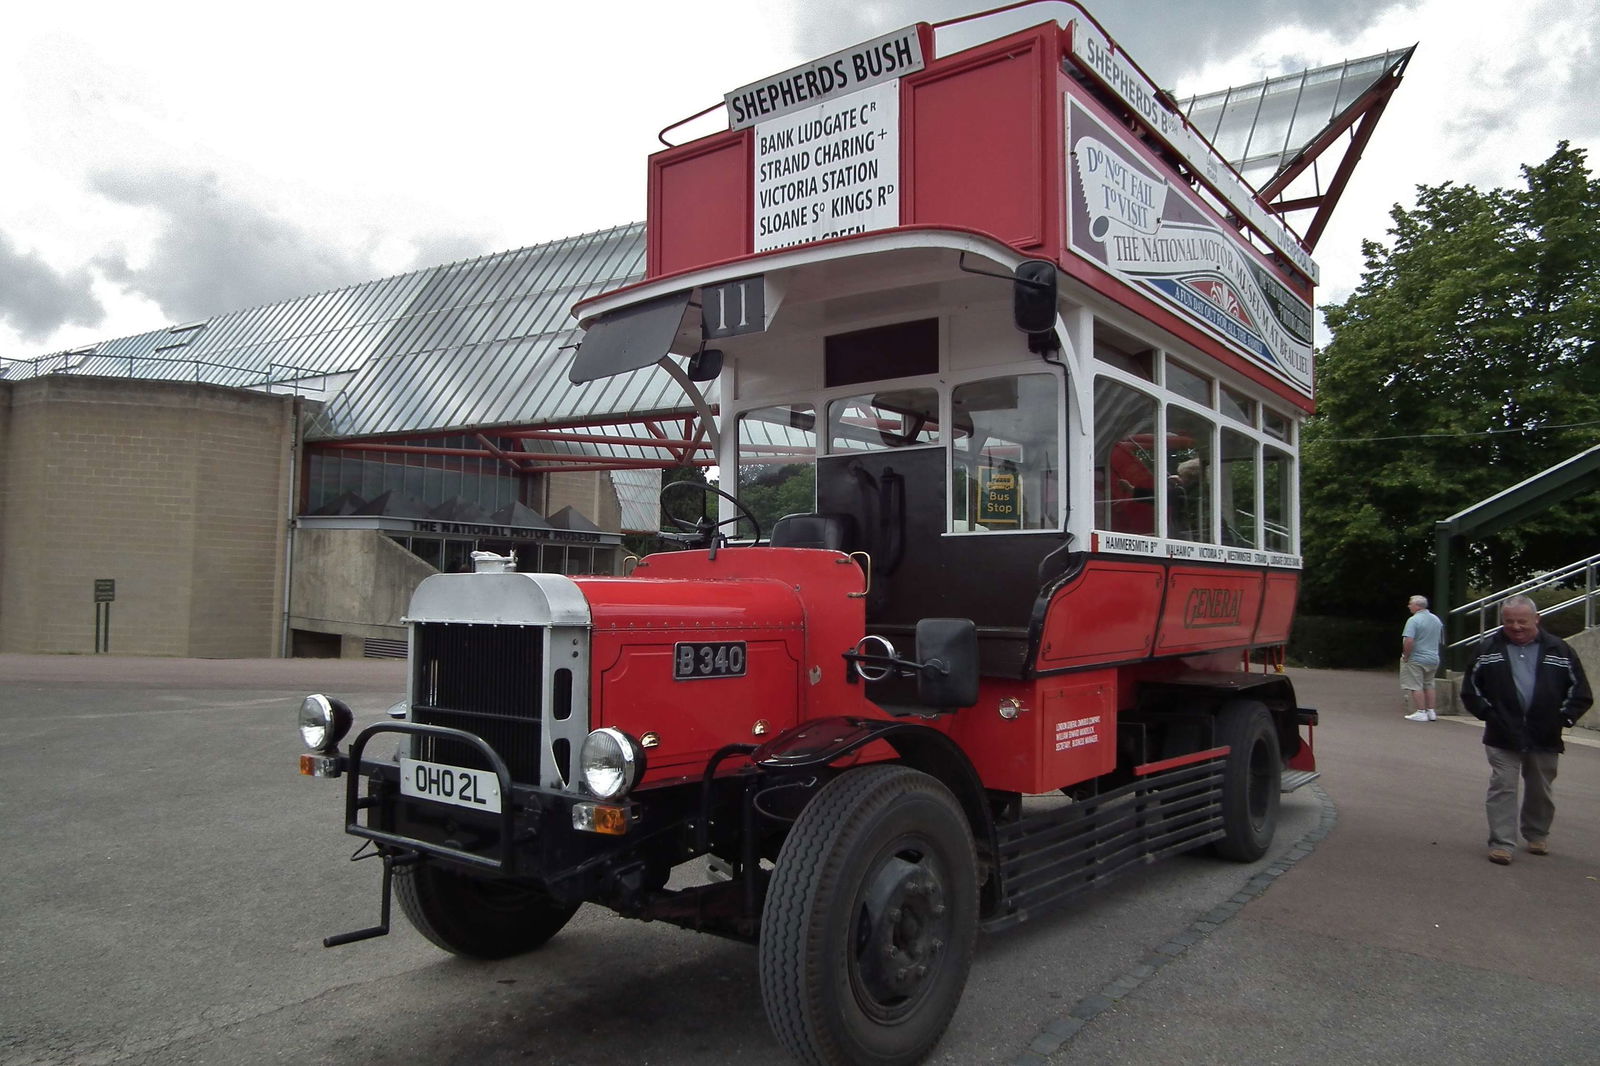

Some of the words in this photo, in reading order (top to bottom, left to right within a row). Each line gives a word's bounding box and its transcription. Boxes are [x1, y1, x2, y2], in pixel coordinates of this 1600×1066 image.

[732, 60, 848, 123] SHEPHERDS
[852, 37, 913, 83] BUSH
[1087, 38, 1158, 127] SHEPHERDS
[760, 127, 794, 157] BANK
[799, 106, 858, 144] LUDGATE
[760, 152, 810, 182] STRAND
[814, 130, 875, 167] CHARING
[760, 176, 818, 209] VICTORIA
[822, 159, 879, 193] STATION
[1131, 173, 1155, 209] FAIL
[760, 205, 808, 237] SLOANE
[831, 188, 873, 219] KINGS
[1117, 193, 1148, 229] VISIT
[1113, 235, 1140, 262] THE
[1141, 237, 1199, 263] NATIONAL
[1200, 239, 1233, 273] MOTOR
[1235, 260, 1269, 333] MUSEUM
[1270, 324, 1279, 348] AT
[1174, 286, 1180, 300] A
[1180, 289, 1194, 307] FUN
[1193, 296, 1205, 314] DAY
[1204, 302, 1217, 323] OUT
[987, 502, 1013, 514] Stop
[989, 491, 1010, 501] Bus
[413, 521, 437, 533] THE
[441, 522, 508, 537] NATIONAL
[511, 527, 551, 540] MOTOR
[553, 530, 601, 543] MUSEUM
[1105, 536, 1149, 553] HAMMERSMITH
[1184, 587, 1244, 627] GENERAL
[679, 645, 695, 675] B
[699, 645, 743, 674] 340
[415, 764, 455, 798] OHO
[458, 772, 487, 805] 2L
